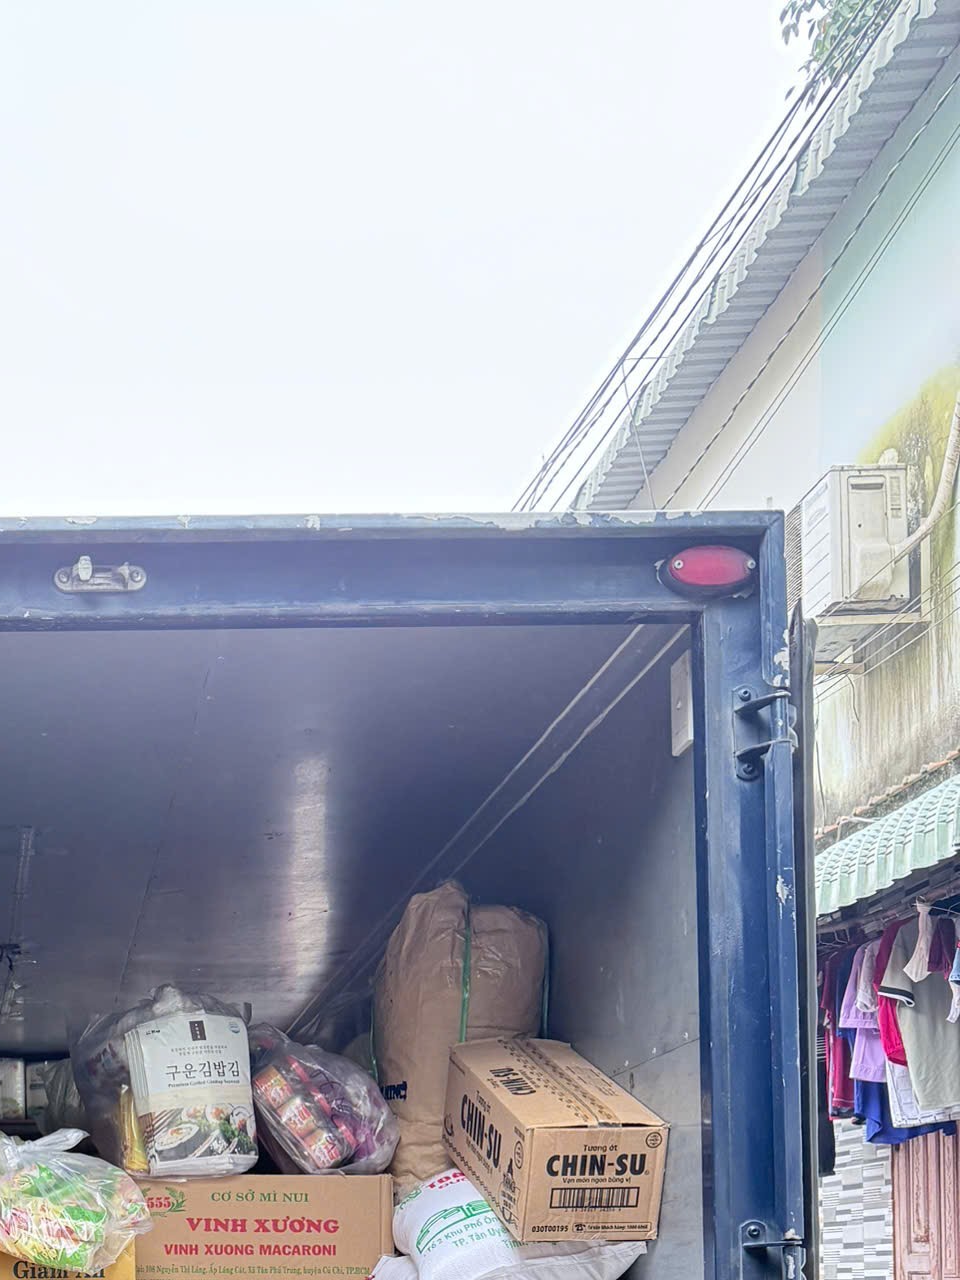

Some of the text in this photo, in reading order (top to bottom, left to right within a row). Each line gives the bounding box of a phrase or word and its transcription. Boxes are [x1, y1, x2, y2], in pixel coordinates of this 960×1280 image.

[166, 1060, 240, 1080] 구운김밥김
[461, 1094, 502, 1169] CHIN-SU
[546, 1153, 647, 1176] CHIN-SU
[147, 1197, 172, 1209] 555
[235, 1189, 255, 1202] SỞ
[259, 1190, 277, 1202] MÌ
[282, 1192, 309, 1203] NUI
[186, 1216, 340, 1234] VINH XƯƠNG
[444, 1228, 463, 1241] Khu
[463, 1219, 483, 1232] Phố
[489, 1226, 510, 1239] Uyê
[164, 1244, 337, 1256] VINH XUONG MACARONI
